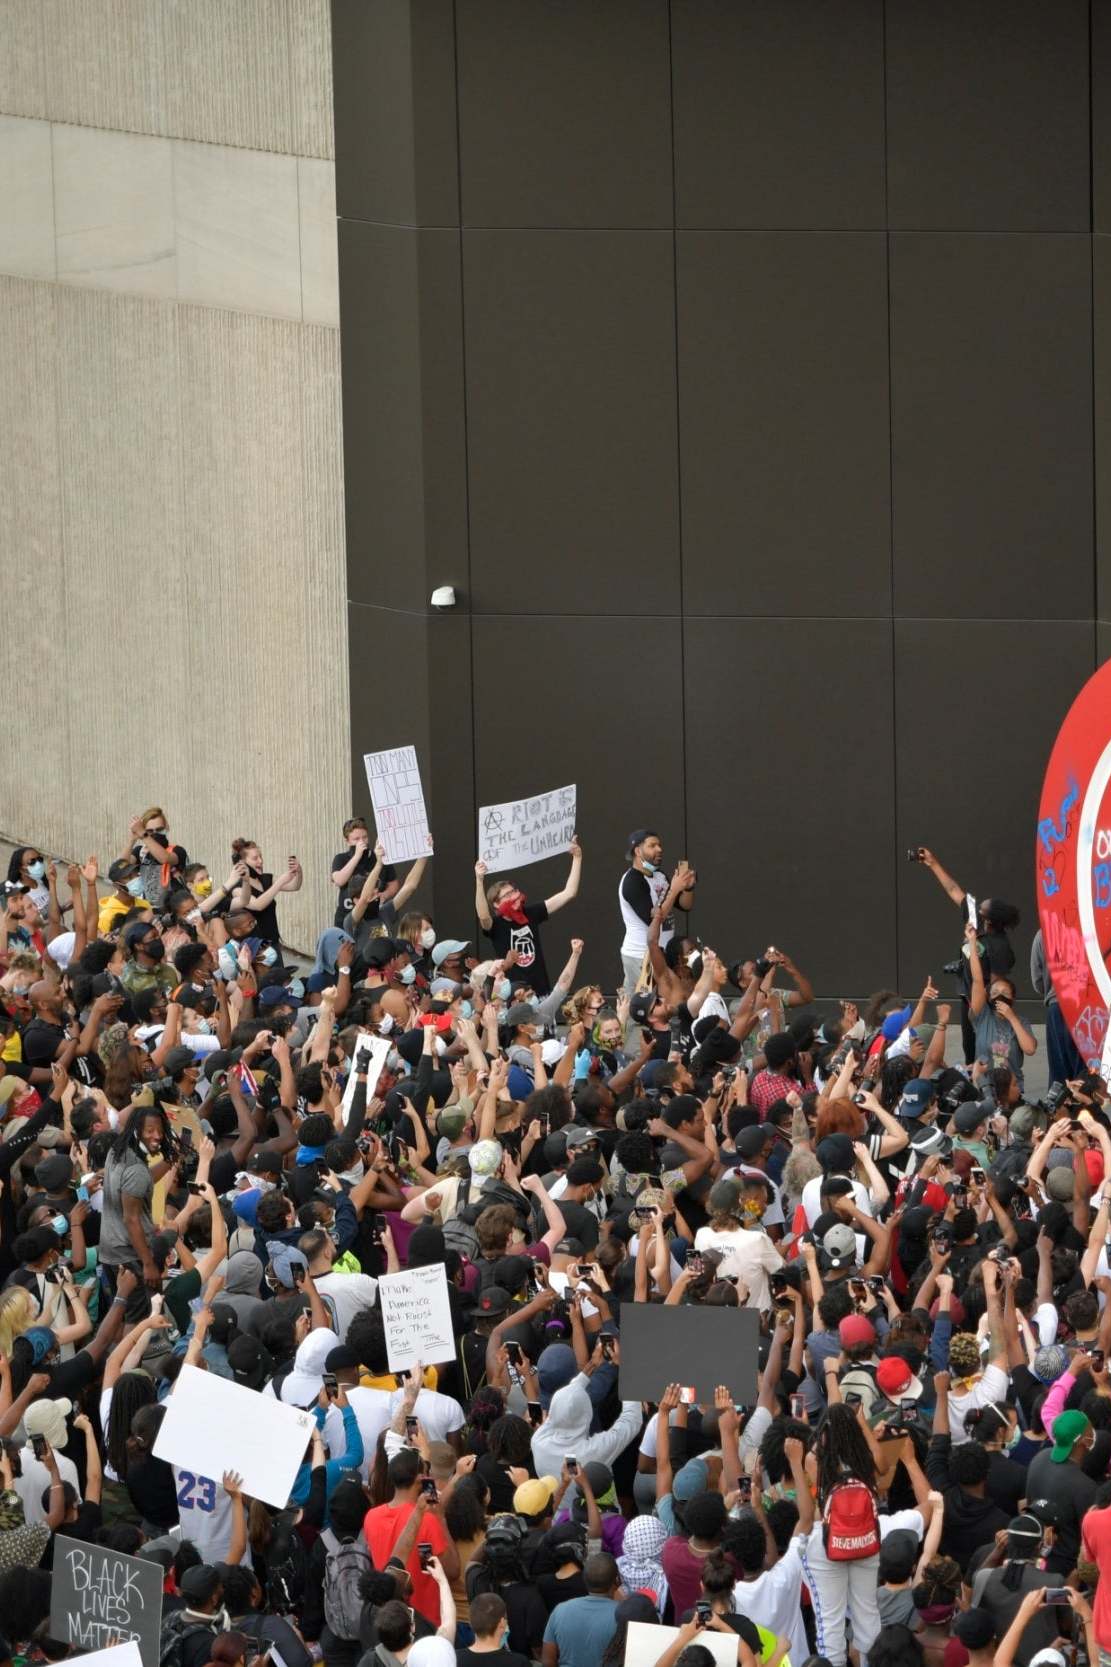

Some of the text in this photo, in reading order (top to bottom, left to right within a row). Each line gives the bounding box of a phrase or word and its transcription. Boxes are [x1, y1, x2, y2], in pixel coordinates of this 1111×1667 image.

[512, 793, 553, 824] RIOT
[179, 1470, 217, 1513] 23
[66, 1549, 145, 1610] BLACK
[82, 1589, 131, 1625] LIVES
